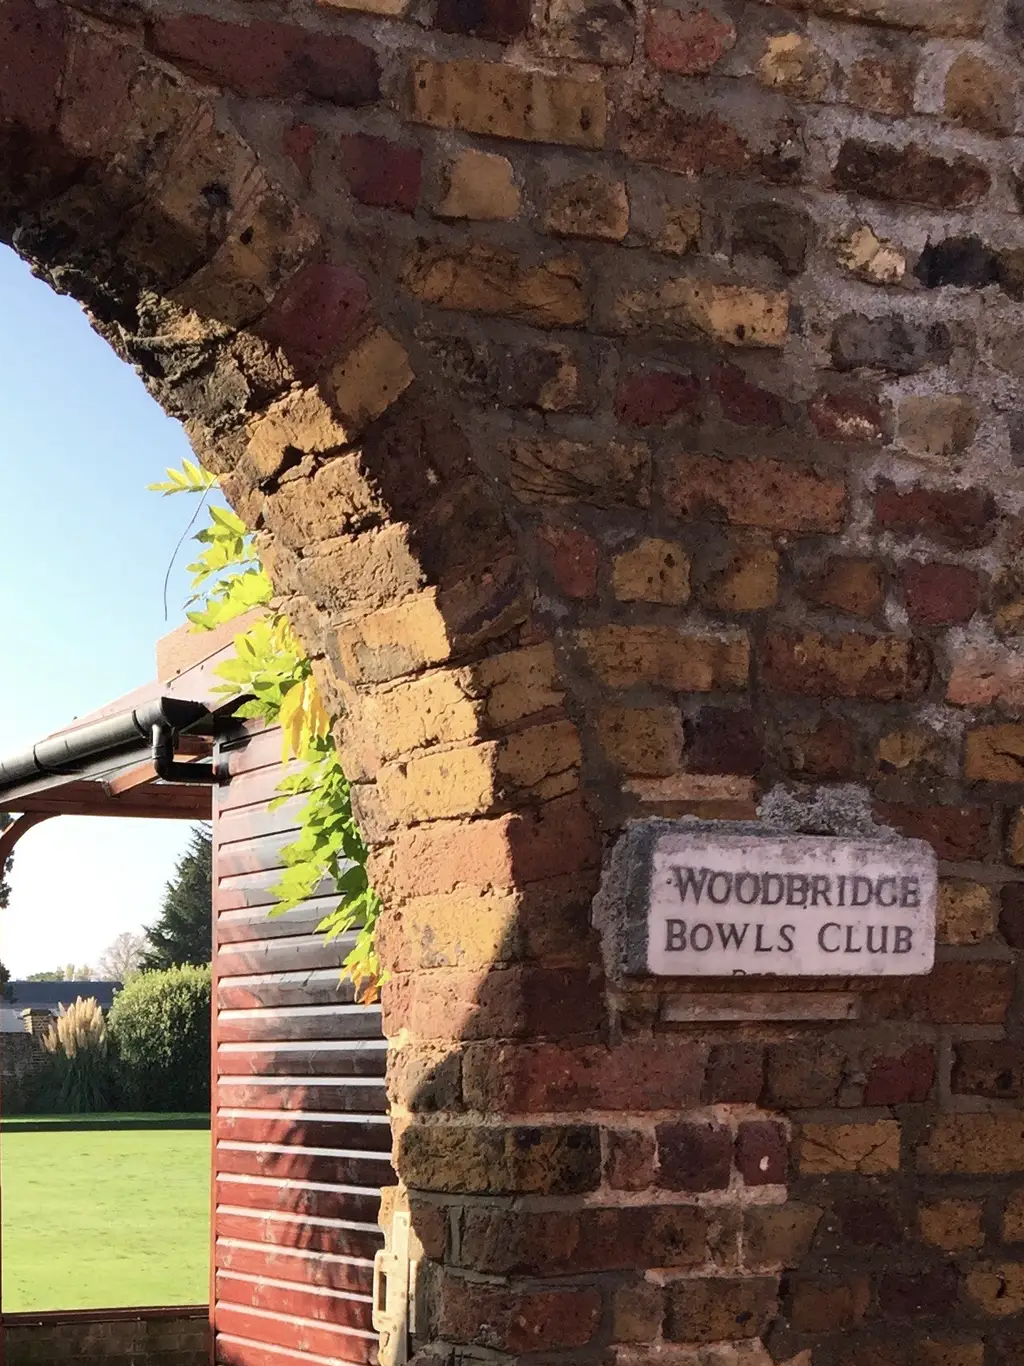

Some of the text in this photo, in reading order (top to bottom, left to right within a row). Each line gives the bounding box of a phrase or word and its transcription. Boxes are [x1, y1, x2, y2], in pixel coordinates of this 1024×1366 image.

[671, 867, 921, 907] WOODBRIDGE
[664, 918, 914, 954] BOWLS CLUB
